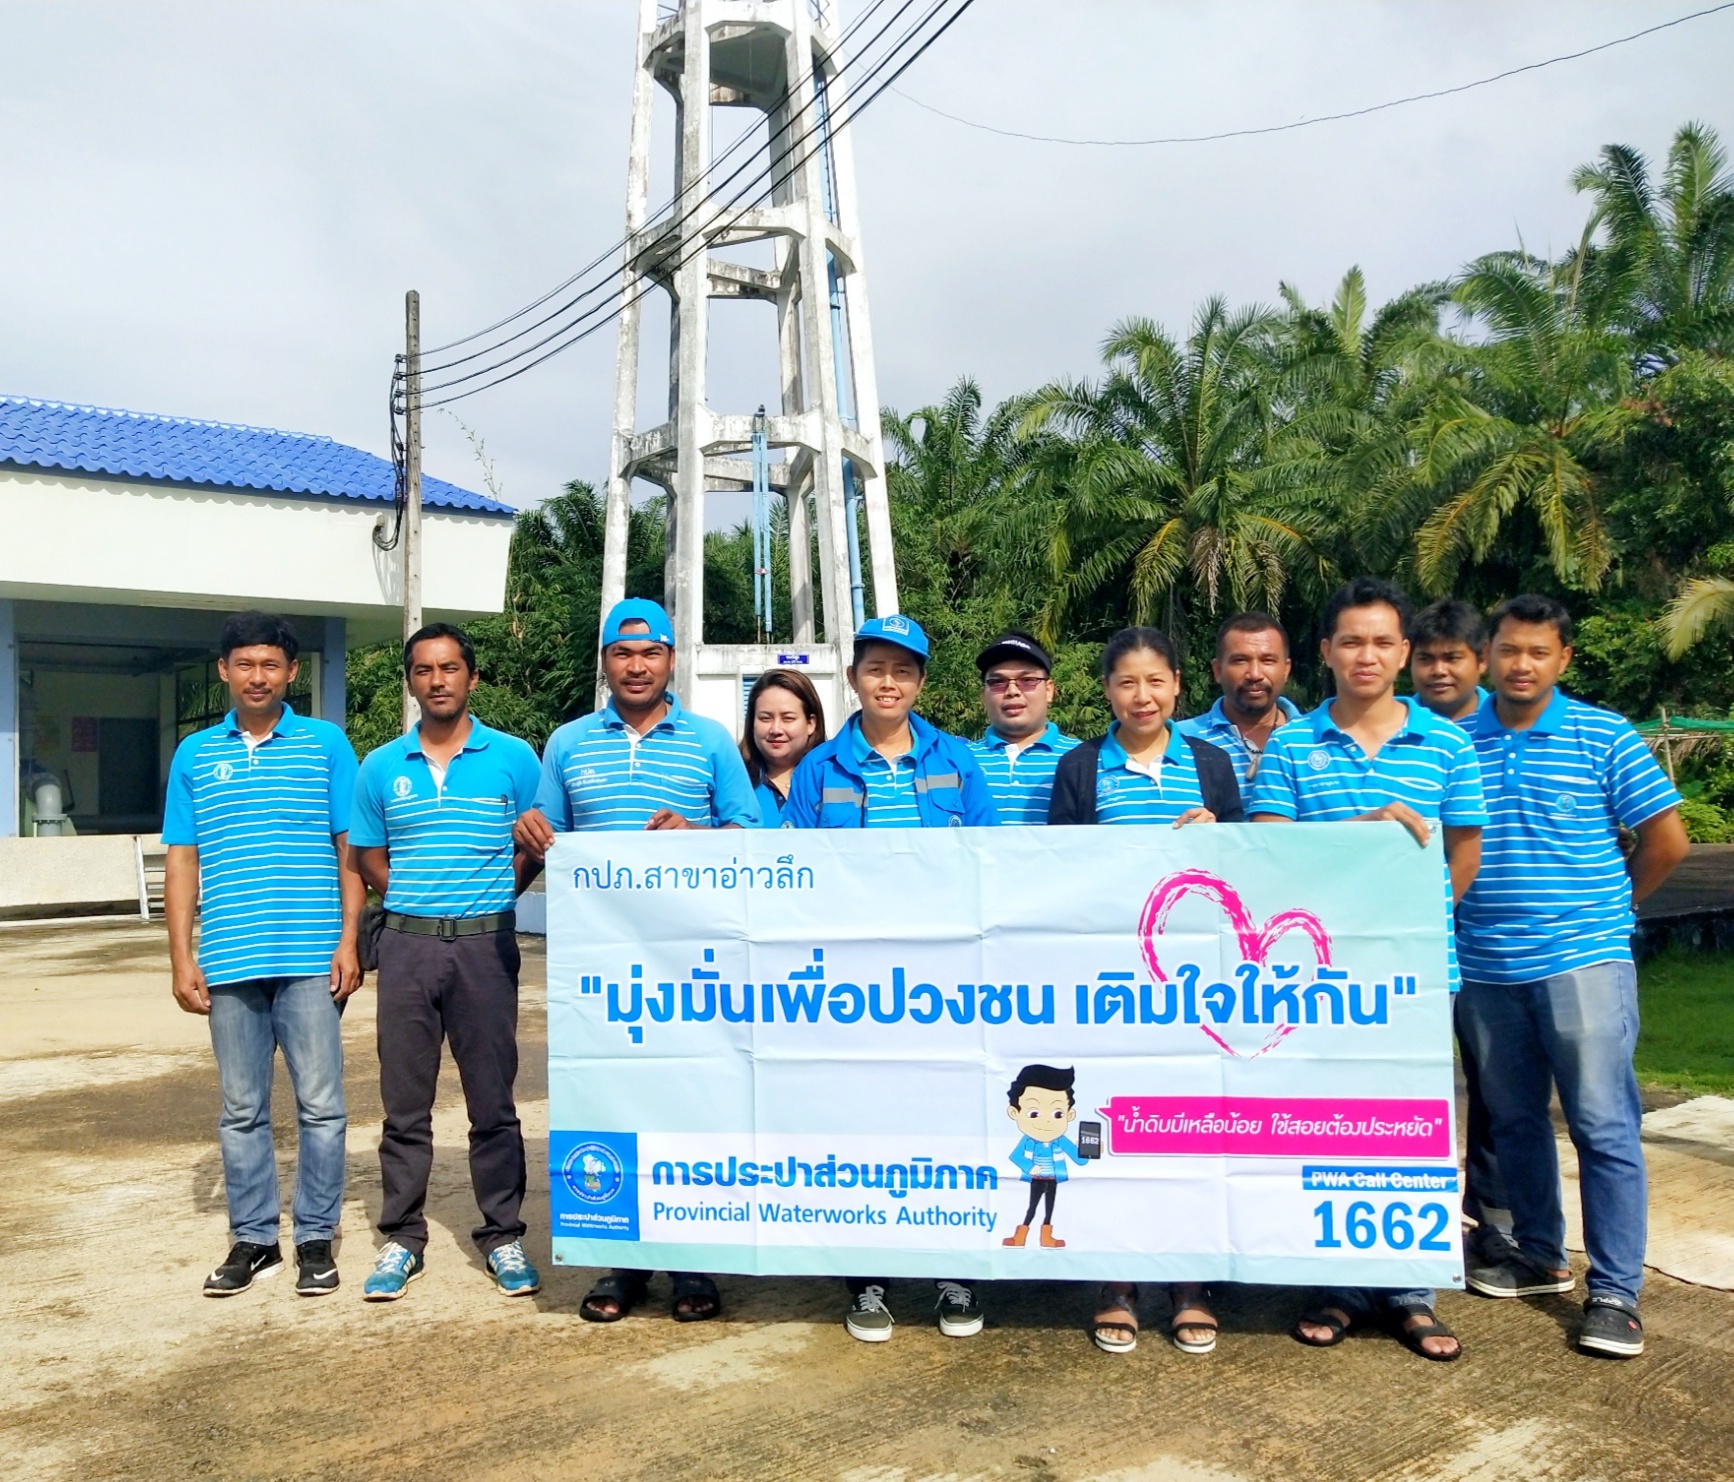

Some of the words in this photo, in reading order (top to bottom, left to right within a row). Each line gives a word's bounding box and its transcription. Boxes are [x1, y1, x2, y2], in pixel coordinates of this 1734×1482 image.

[573, 855, 814, 890] กปภ.สาขาอ่าวลึก
[580, 948, 1054, 1043] "มุ่งมั่นเพื่อปวงชน
[1076, 963, 1416, 1025] เติมใจให้กัน"
[1118, 1106, 1263, 1134] "น้ำดิบมีเหลือน้อย
[1271, 1112, 1442, 1137] ใช้สอยต้องประหยัด"
[652, 1154, 998, 1198] การประปาส่วนภูมิภาค
[1311, 1171, 1351, 1188] PWA
[1353, 1172, 1387, 1188] Call
[1390, 1172, 1448, 1190] Center
[653, 1202, 750, 1222] Provincial
[758, 1203, 886, 1225] Waterworks
[895, 1205, 998, 1232] Authority
[1313, 1200, 1451, 1252] 1662
